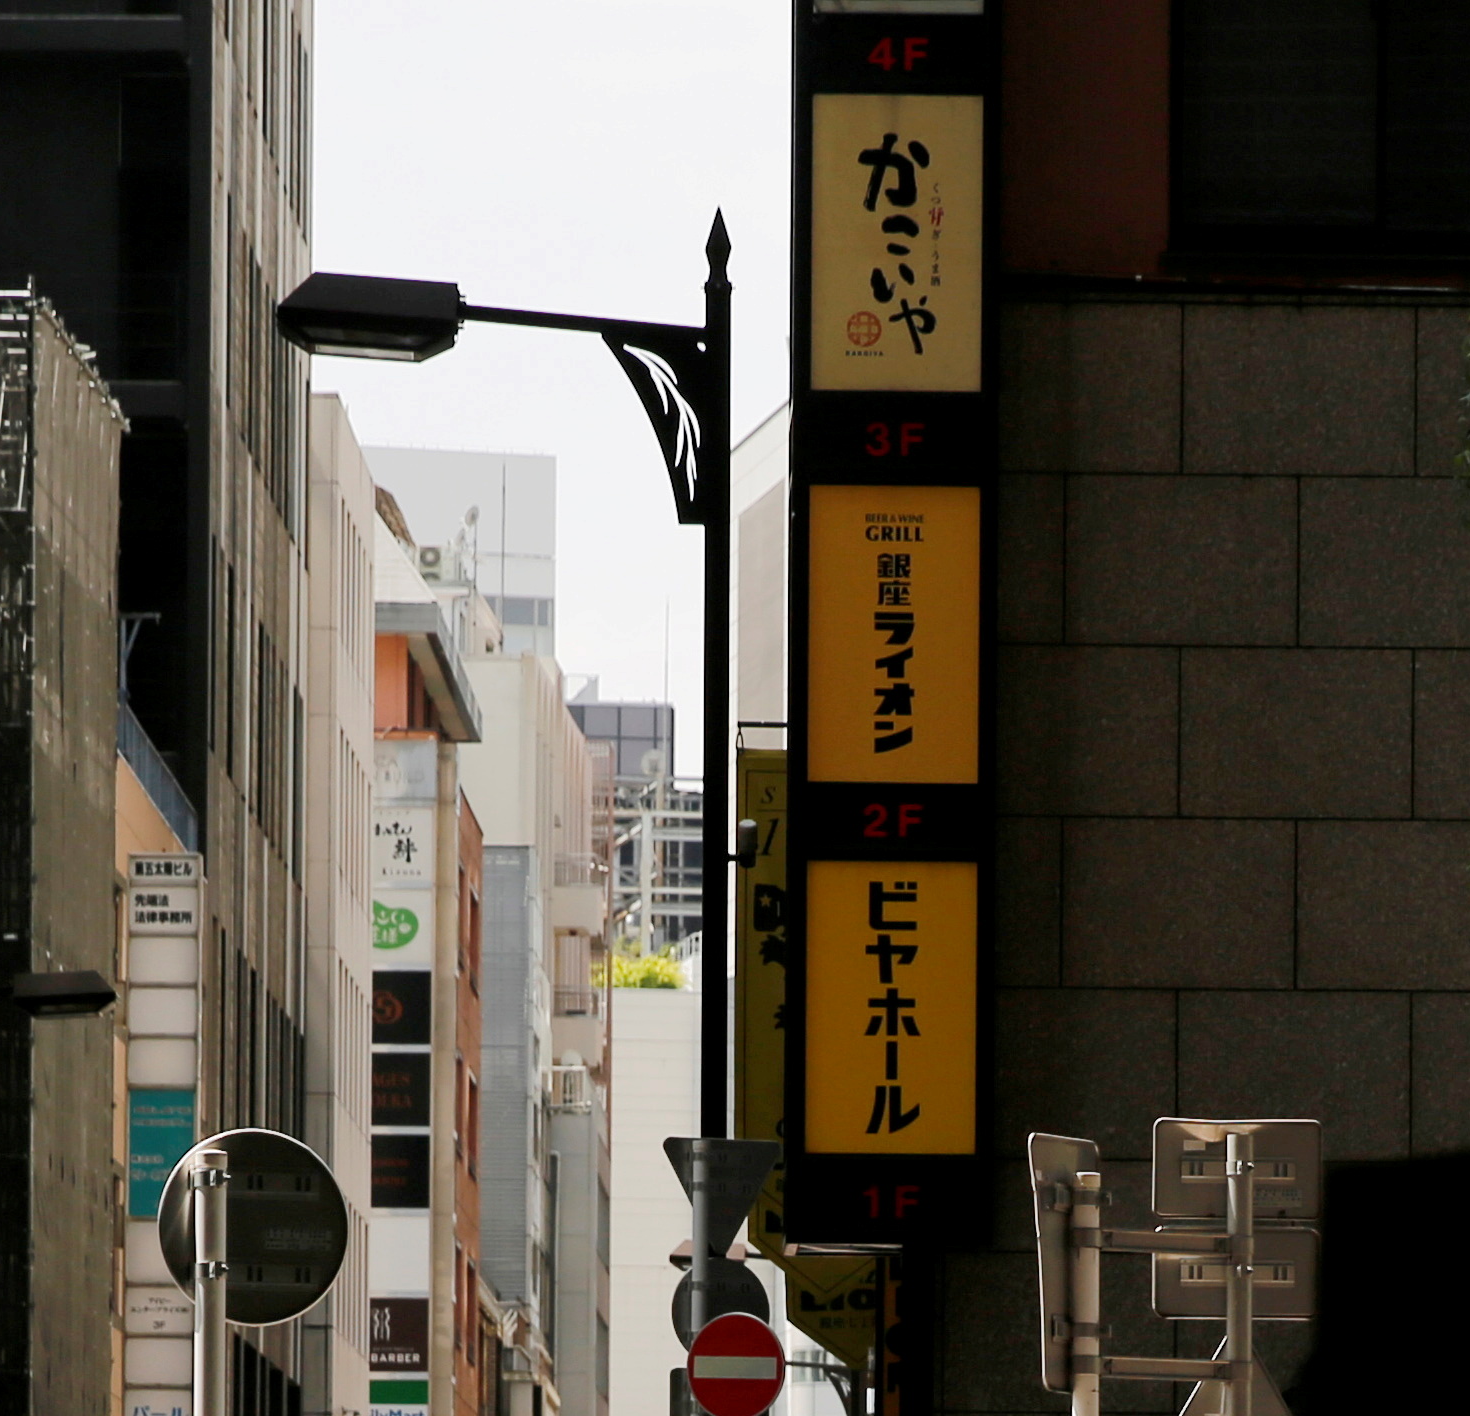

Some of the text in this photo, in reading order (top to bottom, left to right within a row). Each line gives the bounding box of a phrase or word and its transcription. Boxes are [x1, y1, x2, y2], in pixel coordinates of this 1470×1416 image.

[868, 37, 929, 71] 4F
[858, 133, 937, 355] かこいや
[865, 422, 925, 457] 3F
[865, 513, 888, 524] BEER
[899, 514, 925, 524] WINE
[865, 525, 925, 543] GRILL
[874, 552, 915, 754] 銀座ライオン
[863, 804, 923, 837] 2F
[865, 881, 921, 1134] ビヤホール
[863, 1186, 921, 1218] 1F
[371, 1353, 420, 1363] BARBER
